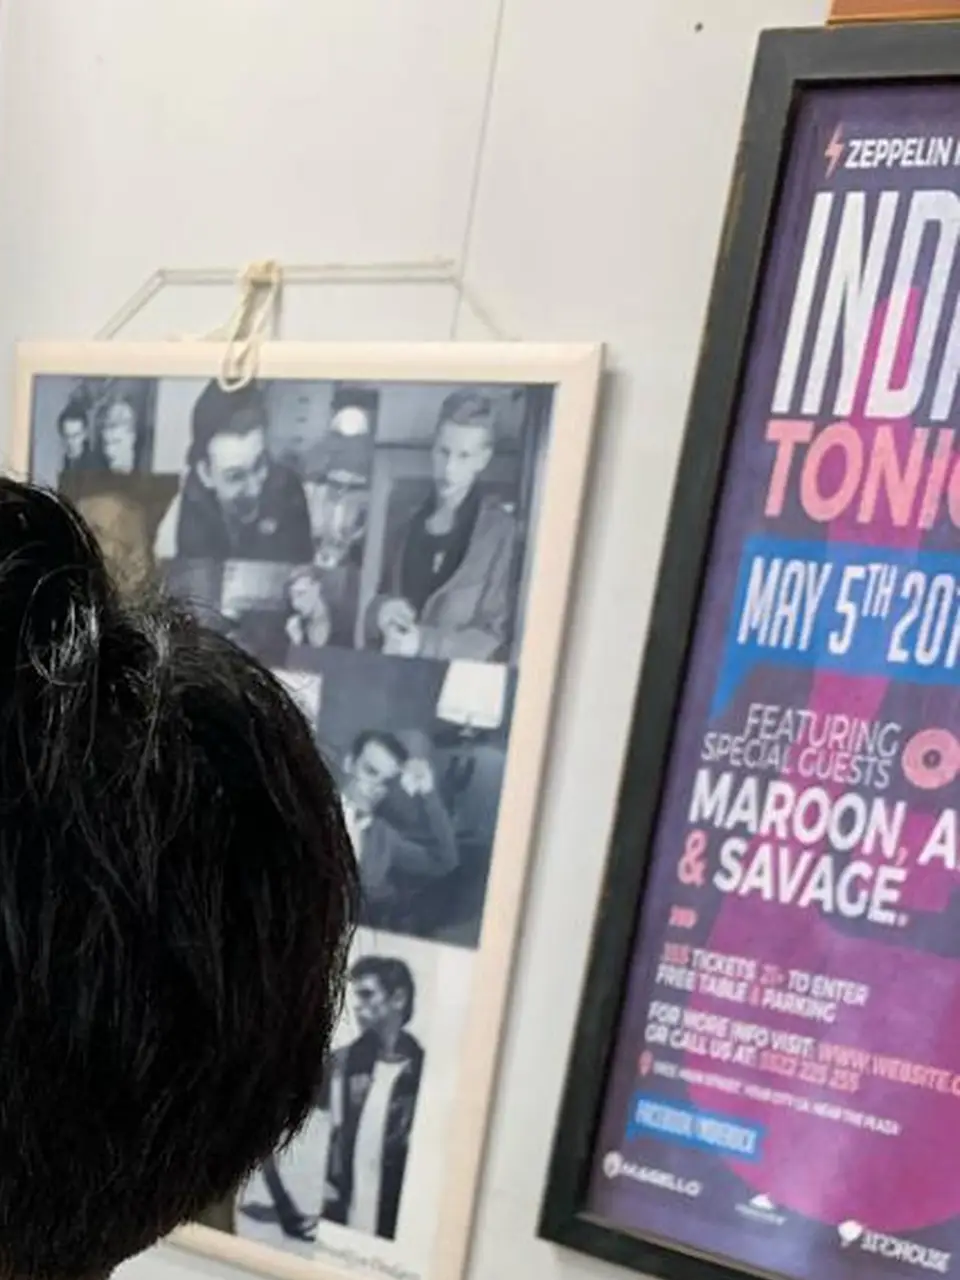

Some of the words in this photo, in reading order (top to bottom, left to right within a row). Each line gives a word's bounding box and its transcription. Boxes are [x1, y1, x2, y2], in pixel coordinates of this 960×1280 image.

[844, 136, 954, 169] ZEPPELIN
[737, 555, 833, 652] MAY
[743, 702, 903, 758] FEATURING
[700, 731, 792, 775] SPECIAL
[797, 746, 893, 790] GUESTS
[677, 830, 707, 888] &
[761, 988, 838, 1024] PARKING
[788, 969, 811, 993] TO
[811, 974, 870, 1007] ENTER
